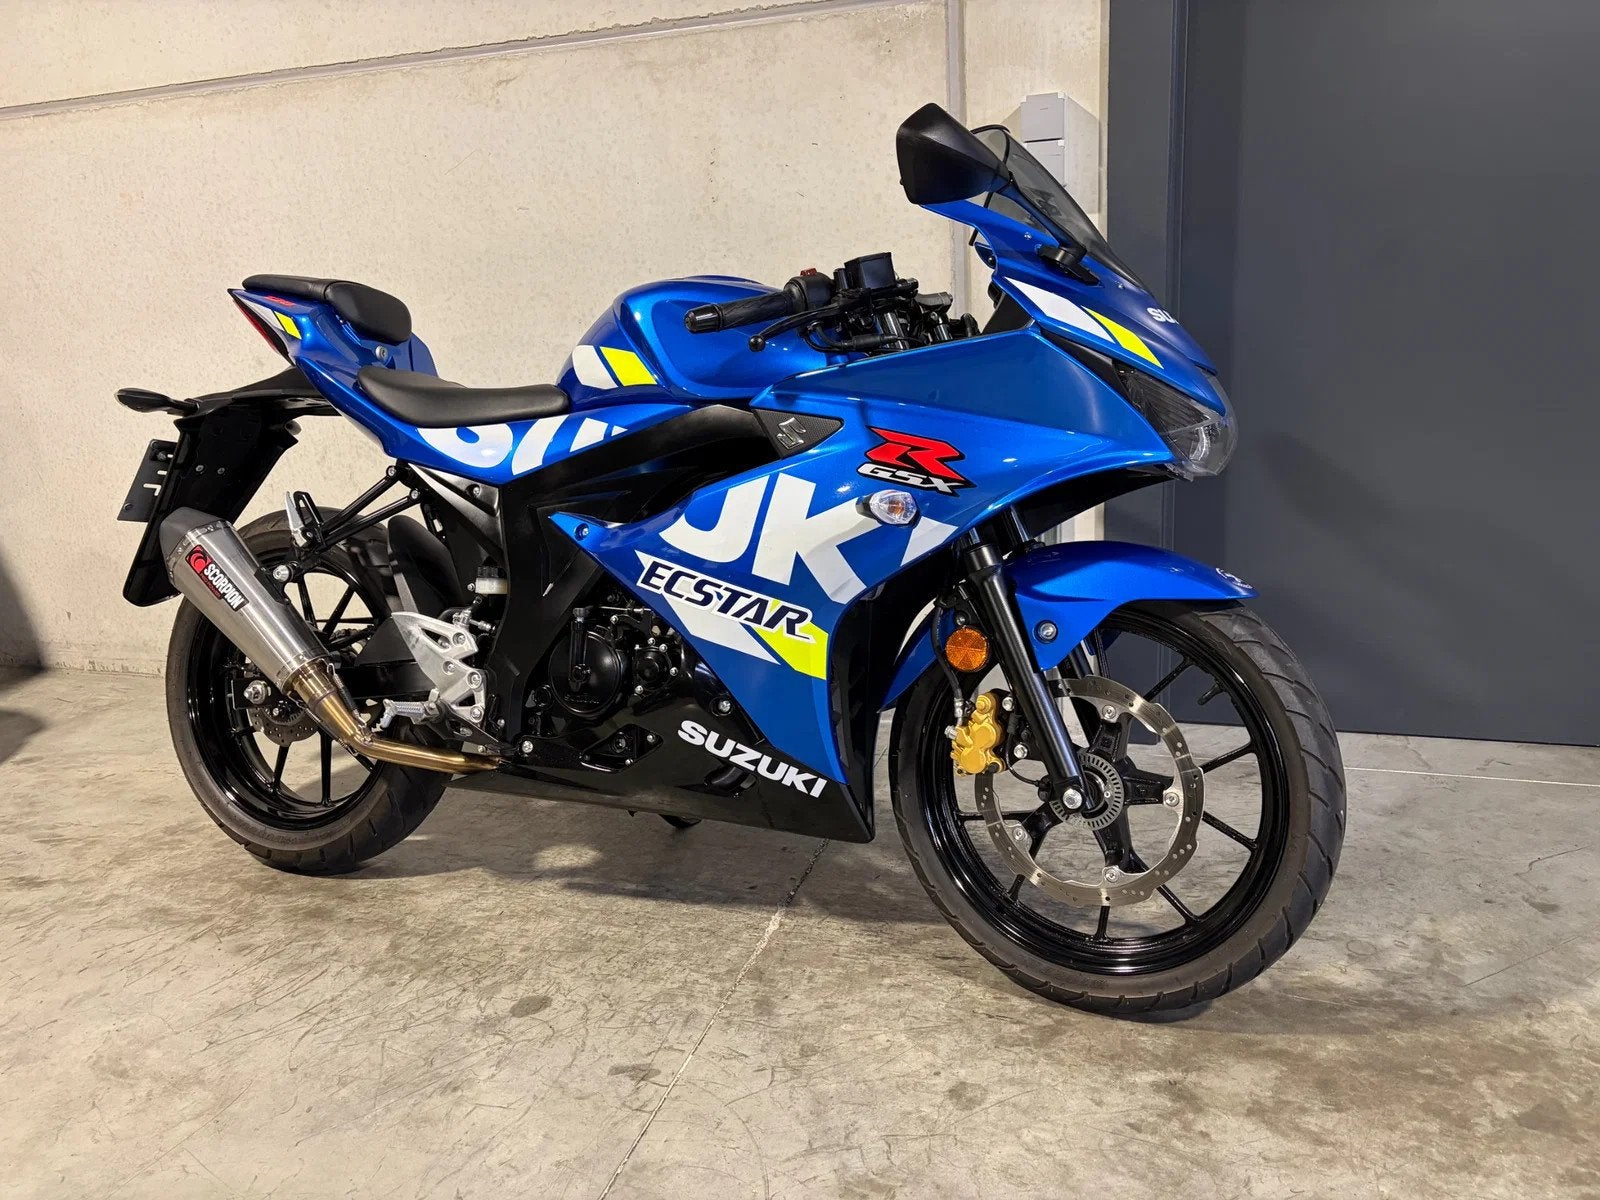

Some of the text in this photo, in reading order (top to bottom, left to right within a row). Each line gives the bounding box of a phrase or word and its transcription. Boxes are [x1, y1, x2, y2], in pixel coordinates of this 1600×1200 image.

[1146, 307, 1180, 325] SU
[857, 463, 965, 494] GSX
[203, 563, 246, 610] SCORPION
[640, 560, 811, 641] ECSTAR
[677, 719, 828, 799] SUZUKI
